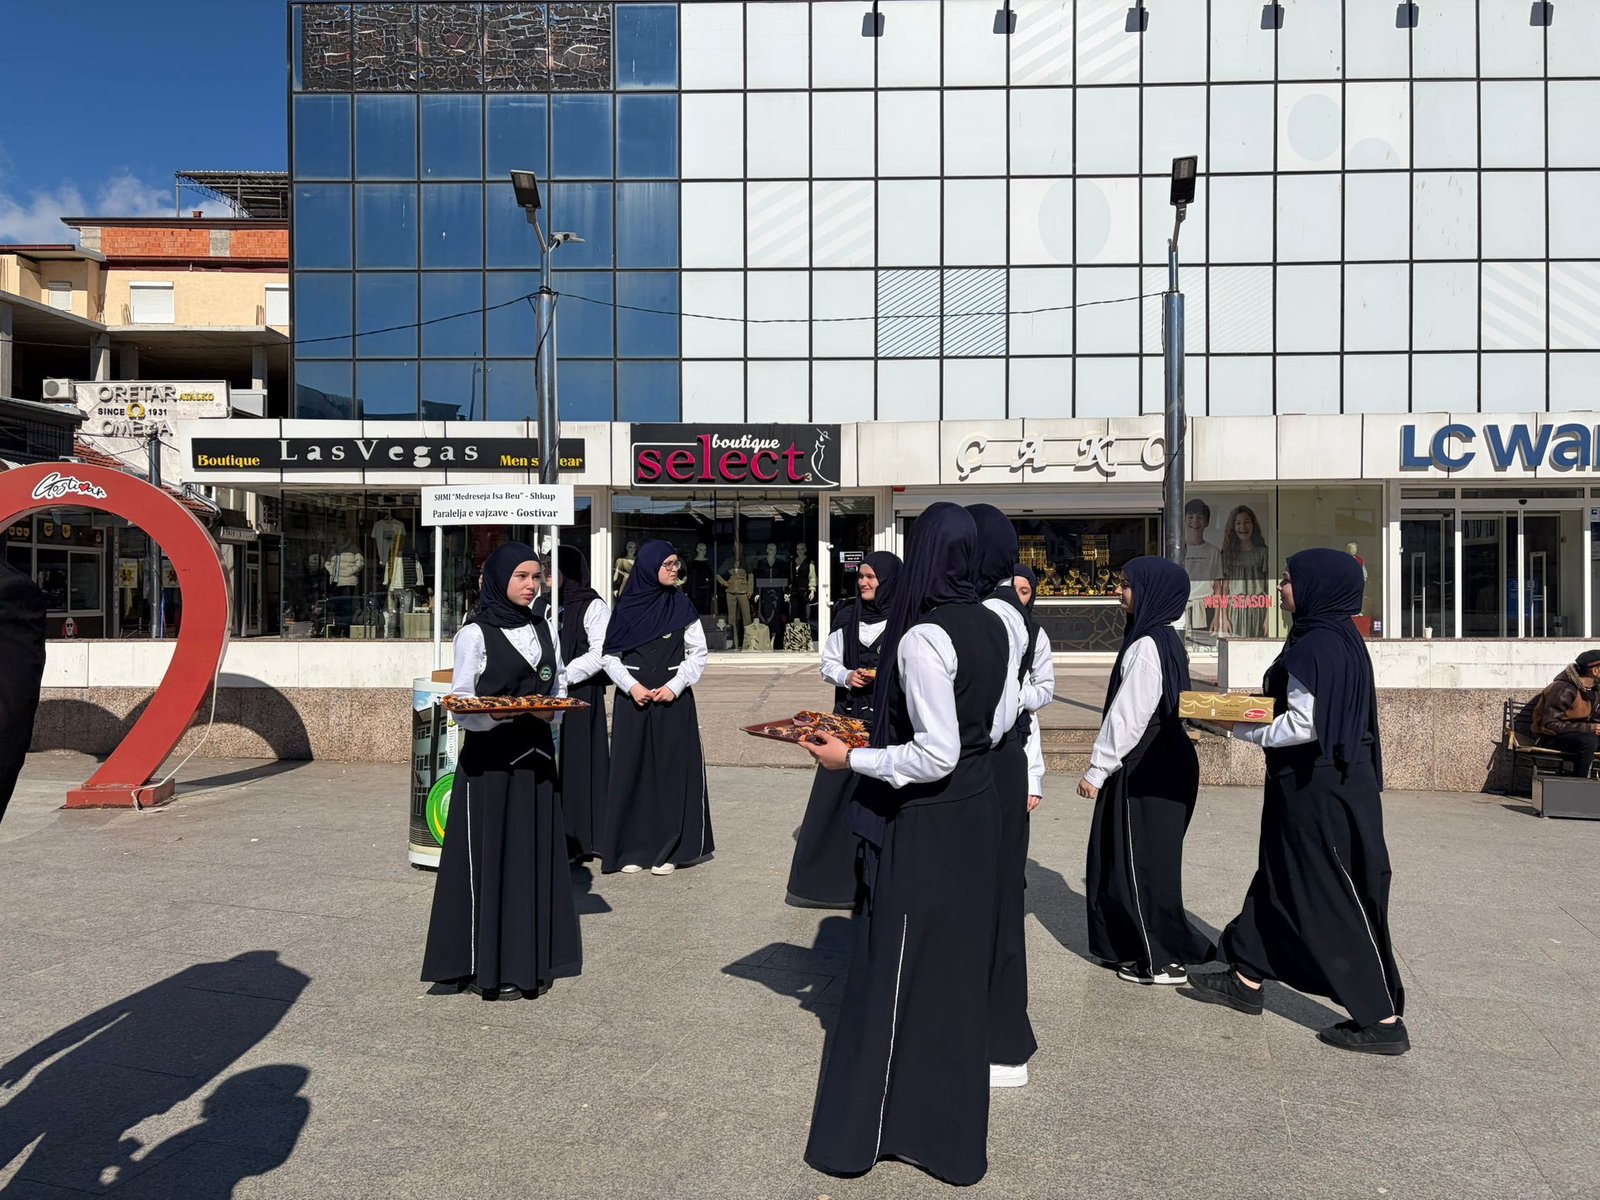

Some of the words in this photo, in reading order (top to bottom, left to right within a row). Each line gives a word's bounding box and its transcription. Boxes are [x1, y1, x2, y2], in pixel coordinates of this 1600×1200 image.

[98, 384, 178, 403] ORETAR
[148, 408, 168, 416] 1931
[102, 420, 174, 437] OMEGA
[712, 434, 780, 453] boutique
[1400, 423, 1476, 472] LC
[1483, 423, 1600, 472] Wa
[197, 454, 261, 468] Boutique
[637, 434, 805, 482] select
[434, 493, 451, 501] SHMI
[452, 493, 491, 501] "Medreseja
[492, 492, 504, 500] Isa
[505, 492, 524, 500] Beu"
[530, 492, 556, 501] Shkup
[432, 509, 467, 519] Paralelja
[475, 509, 508, 518] vajzave
[516, 508, 558, 517] Gostivar
[1204, 595, 1229, 608] NEW
[1232, 595, 1273, 608] SEASON
